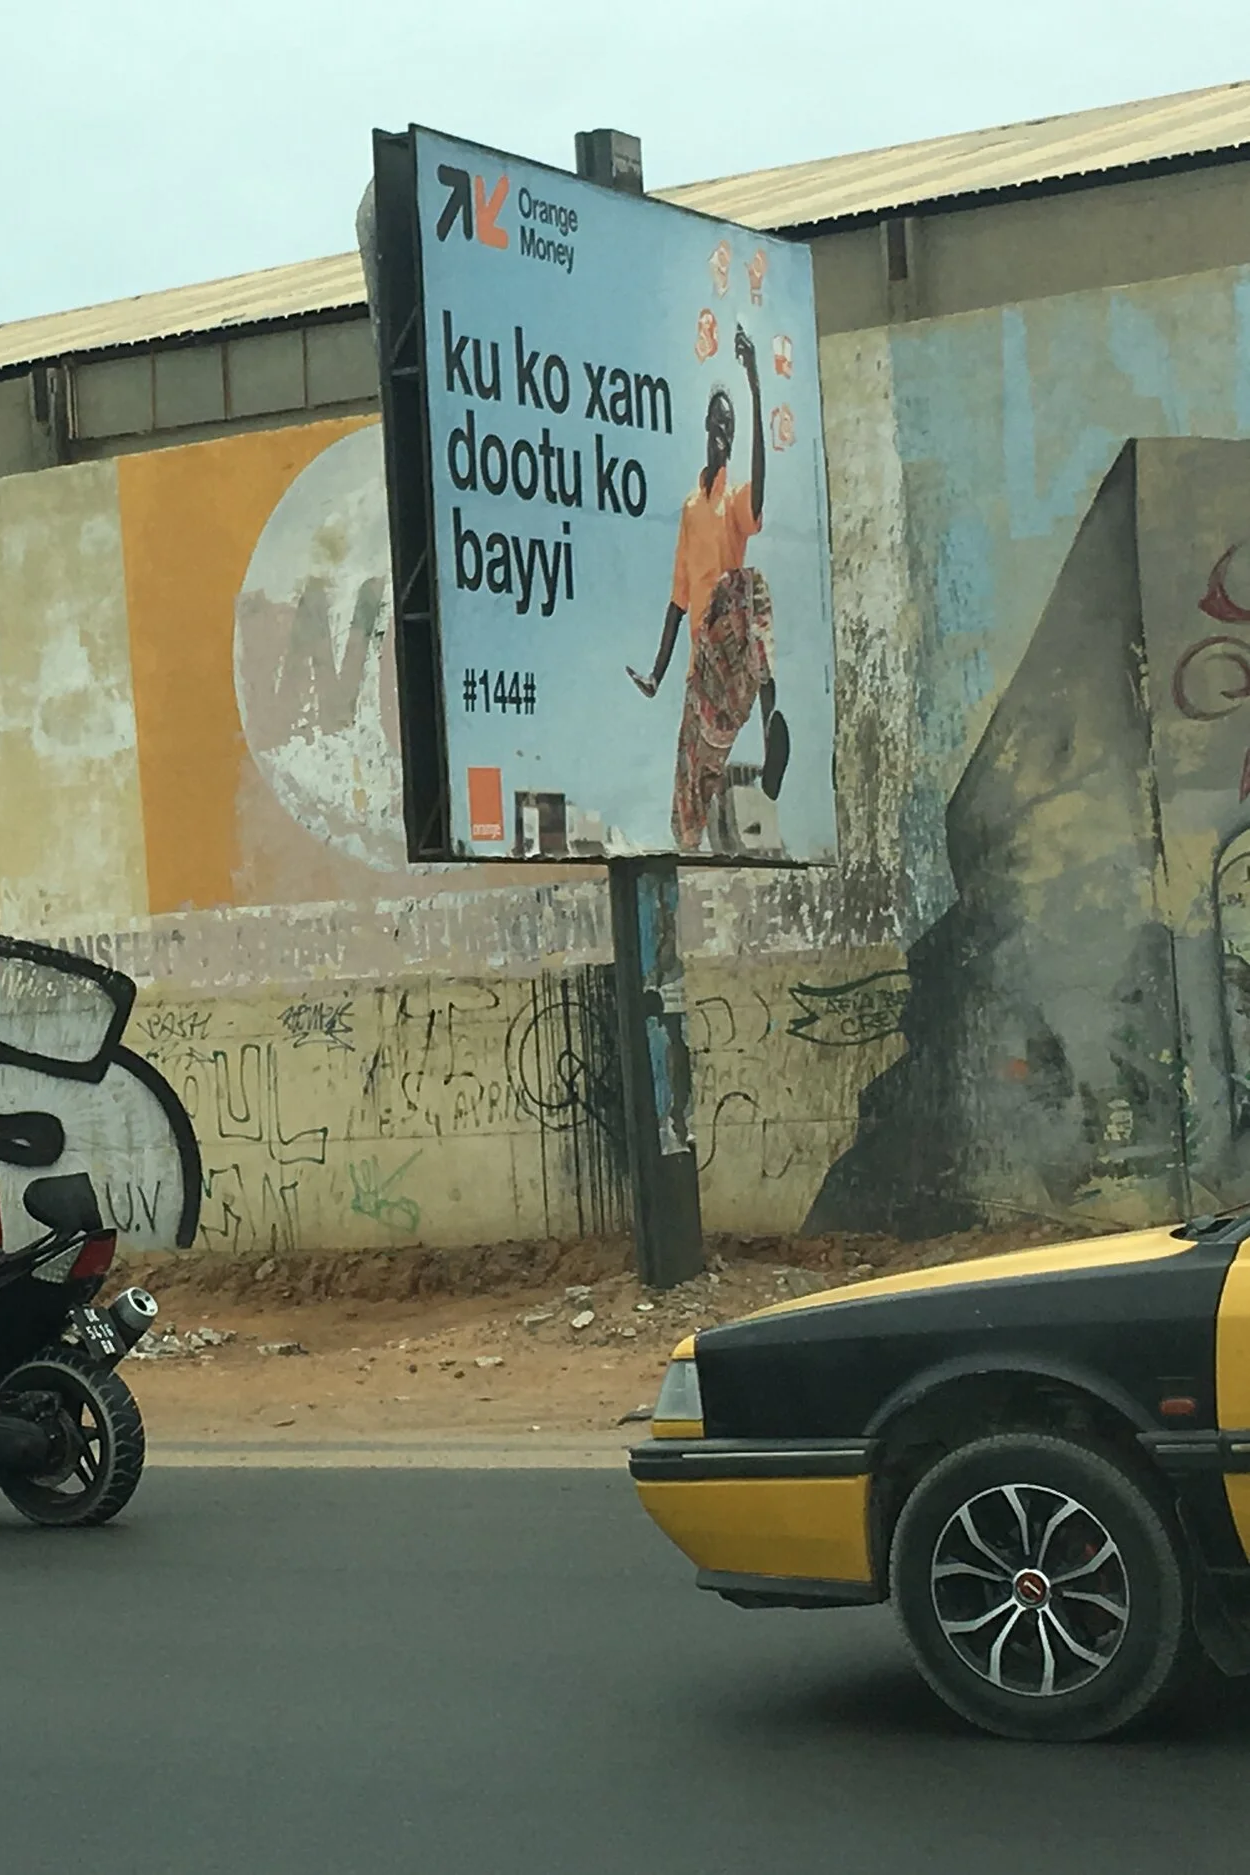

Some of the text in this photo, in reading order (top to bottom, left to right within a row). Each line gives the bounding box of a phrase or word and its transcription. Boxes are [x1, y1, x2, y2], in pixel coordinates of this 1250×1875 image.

[518, 186, 579, 233] Orange
[519, 225, 575, 274] Money
[443, 310, 673, 435] ku ko xam
[449, 410, 648, 518] dootu ko
[452, 507, 576, 617] bayyi
[462, 668, 537, 716] #144#
